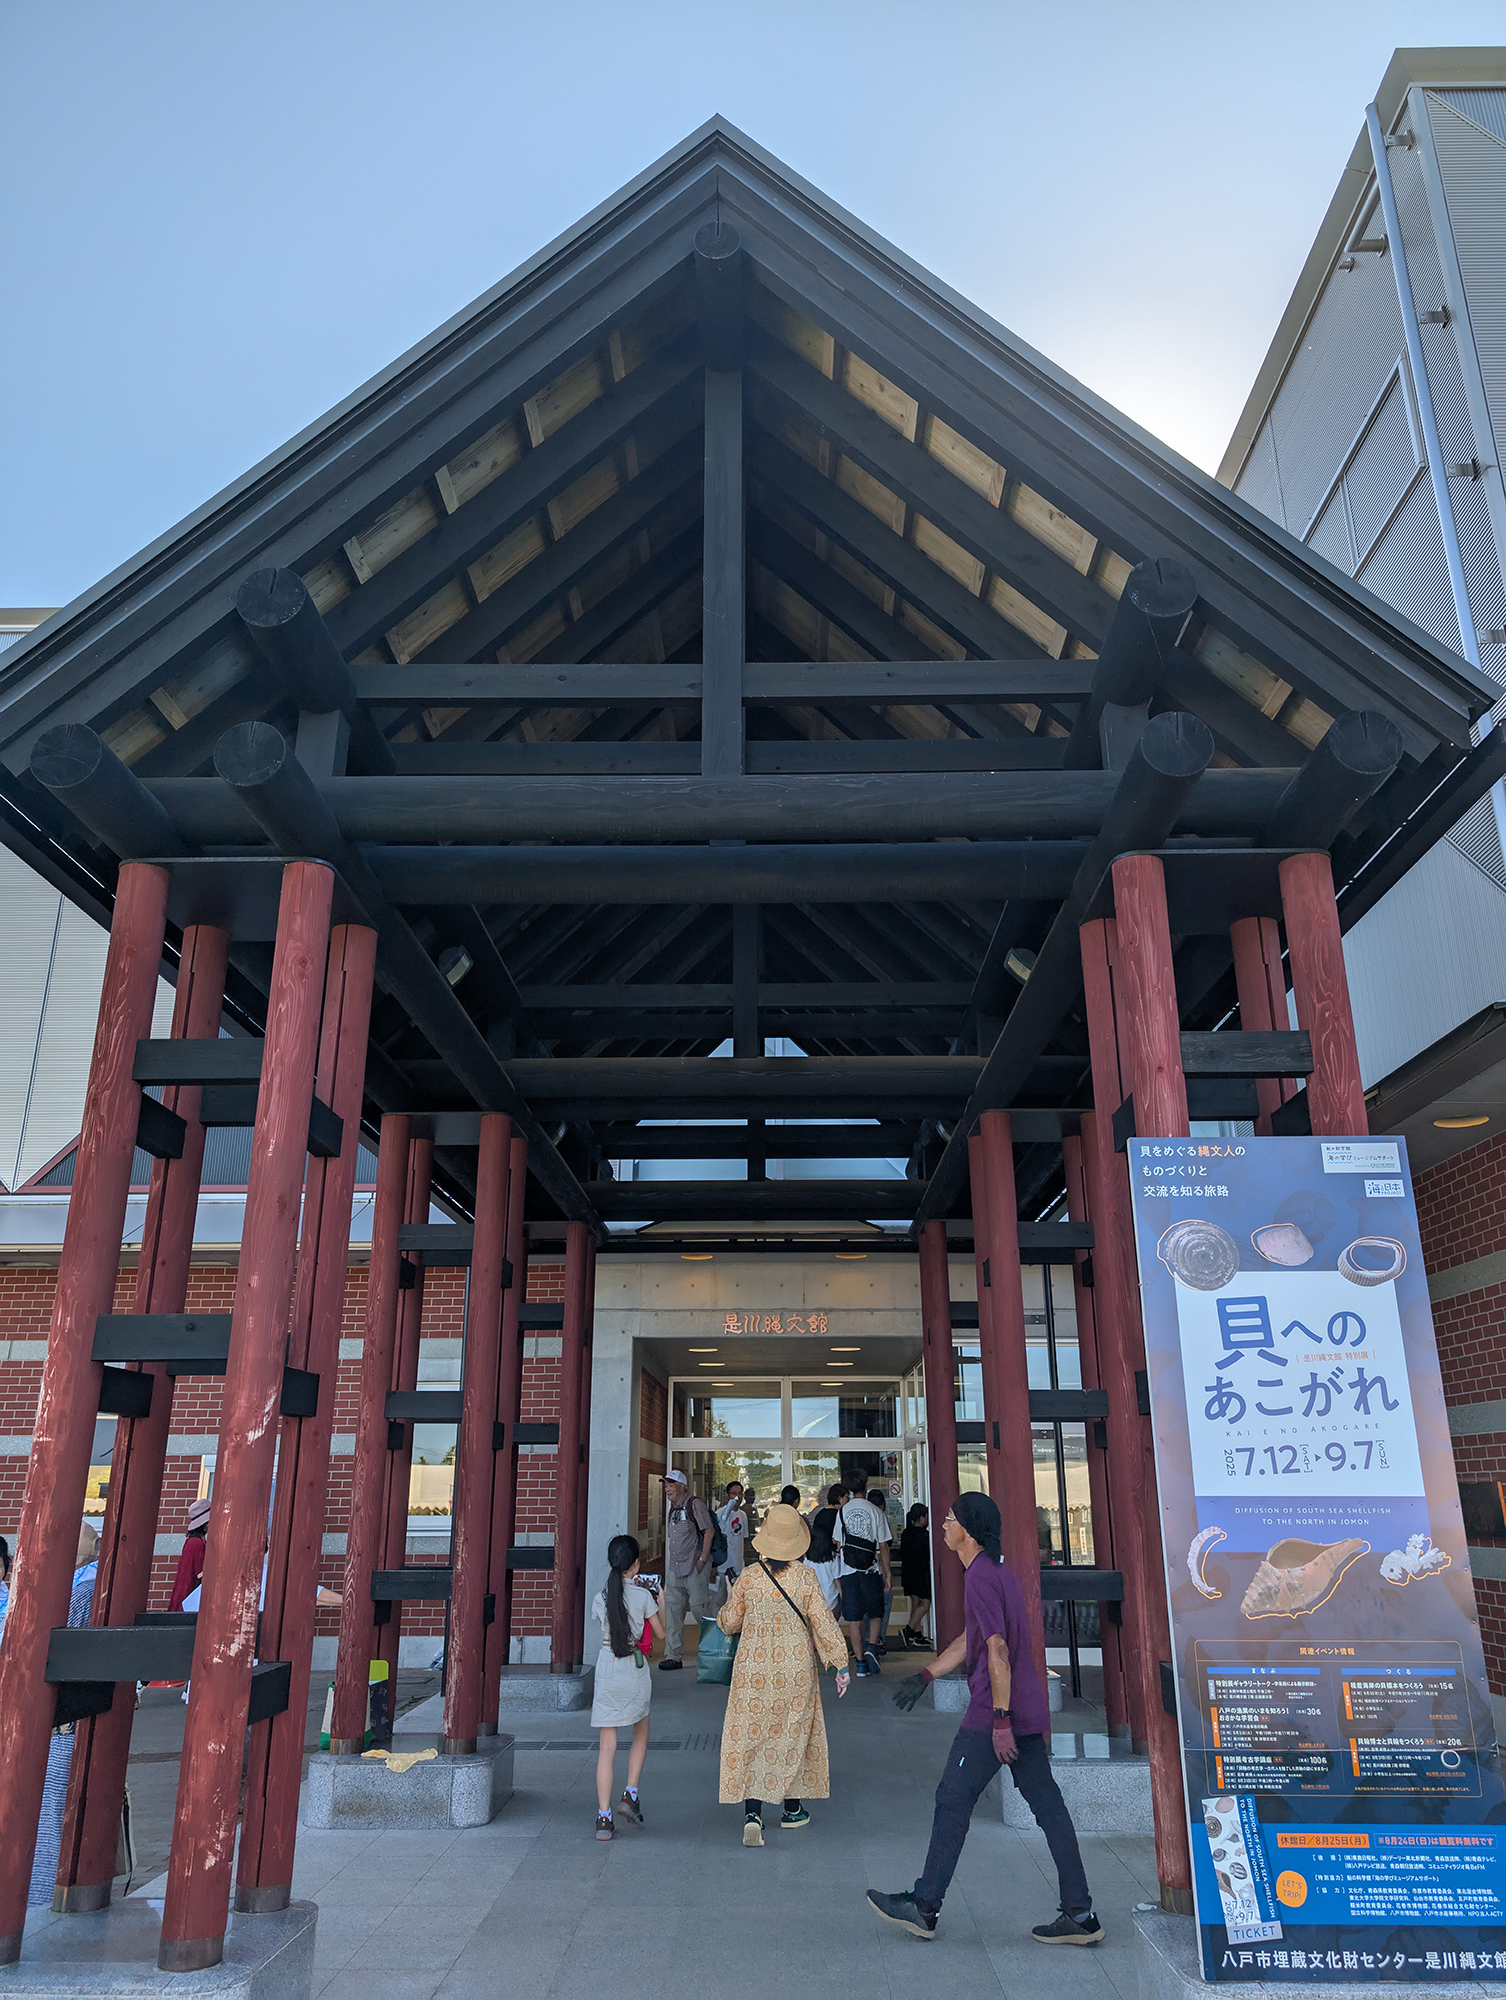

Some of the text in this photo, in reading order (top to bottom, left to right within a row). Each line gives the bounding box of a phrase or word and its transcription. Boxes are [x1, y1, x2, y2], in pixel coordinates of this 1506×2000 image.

[1140, 1145, 1246, 1157] 貝をめぐる縄文人の
[1142, 1165, 1208, 1177] ものづくりと
[1143, 1185, 1229, 1197] 交流を知る旅路
[722, 1312, 829, 1335] 是川縄文館
[1215, 1295, 1367, 1371] 貝への
[1204, 1366, 1400, 1425] あこがれ
[1263, 1428, 1268, 1436] E
[1281, 1427, 1298, 1435] NO
[1311, 1422, 1380, 1433] AKOGARE
[1223, 1449, 1236, 1477] 2025
[1235, 1444, 1301, 1477] 7.12
[1324, 1440, 1374, 1472] 9.7
[1282, 1879, 1303, 1889] LET'S
[1282, 1889, 1302, 1900] TRIP!
[1233, 1925, 1276, 1940] TICKET
[1221, 1950, 1506, 1970] 八戸市埋蔵文化財センター是川縄文館
